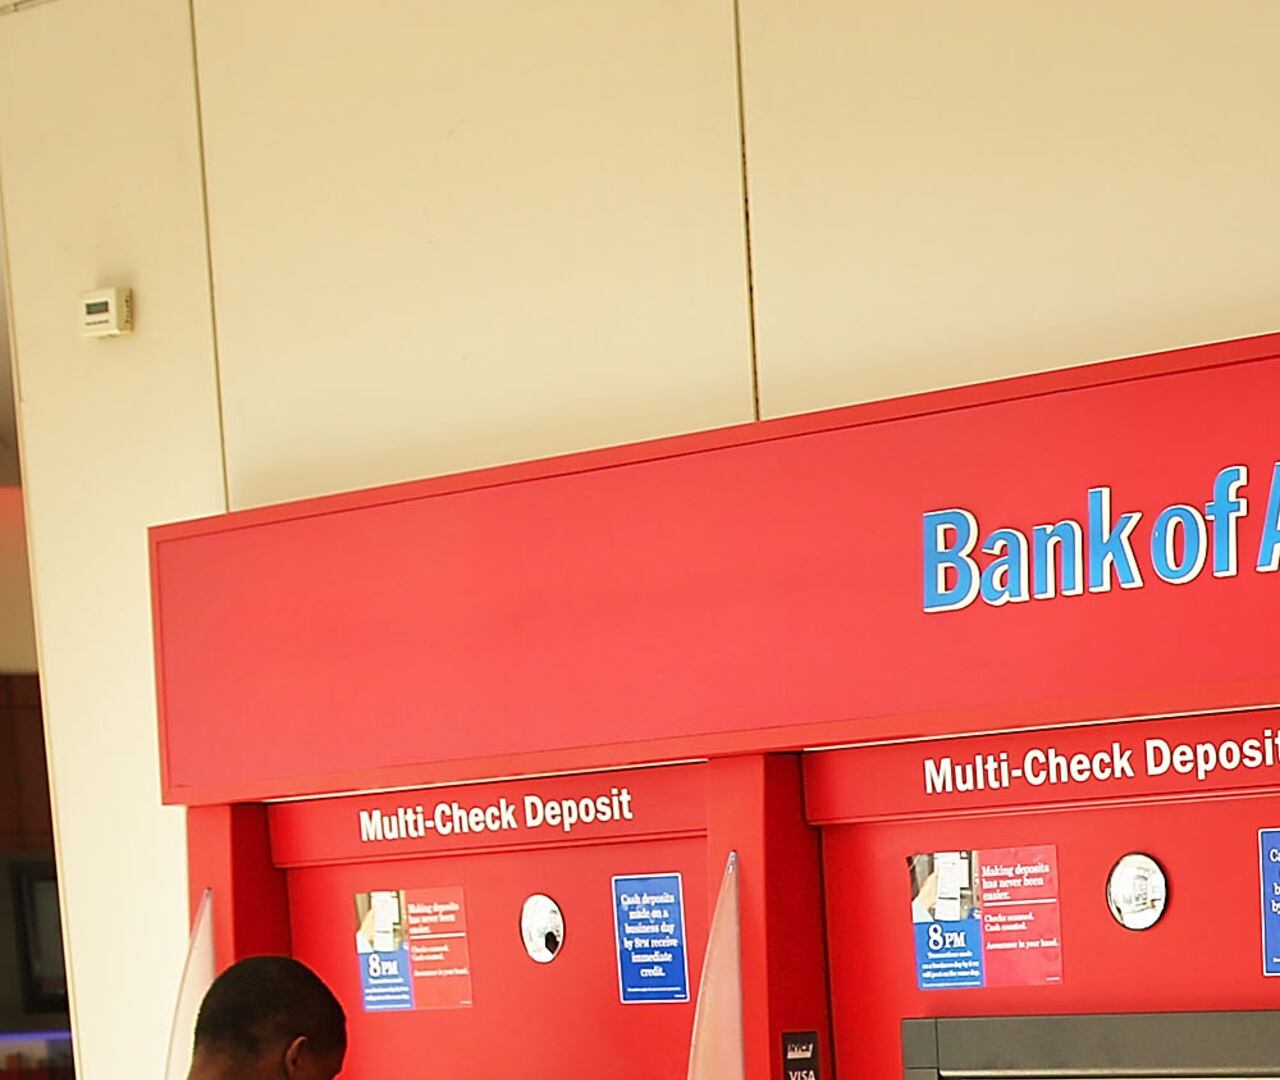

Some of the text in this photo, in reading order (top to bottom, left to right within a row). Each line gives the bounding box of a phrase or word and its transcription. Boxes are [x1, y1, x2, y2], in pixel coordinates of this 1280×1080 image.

[923, 487, 1142, 613] Bank
[1150, 465, 1247, 584] of
[923, 743, 1134, 794] Multi-Check
[360, 788, 633, 841] Multi-Check Deposit
[928, 924, 966, 950] 8 PM
